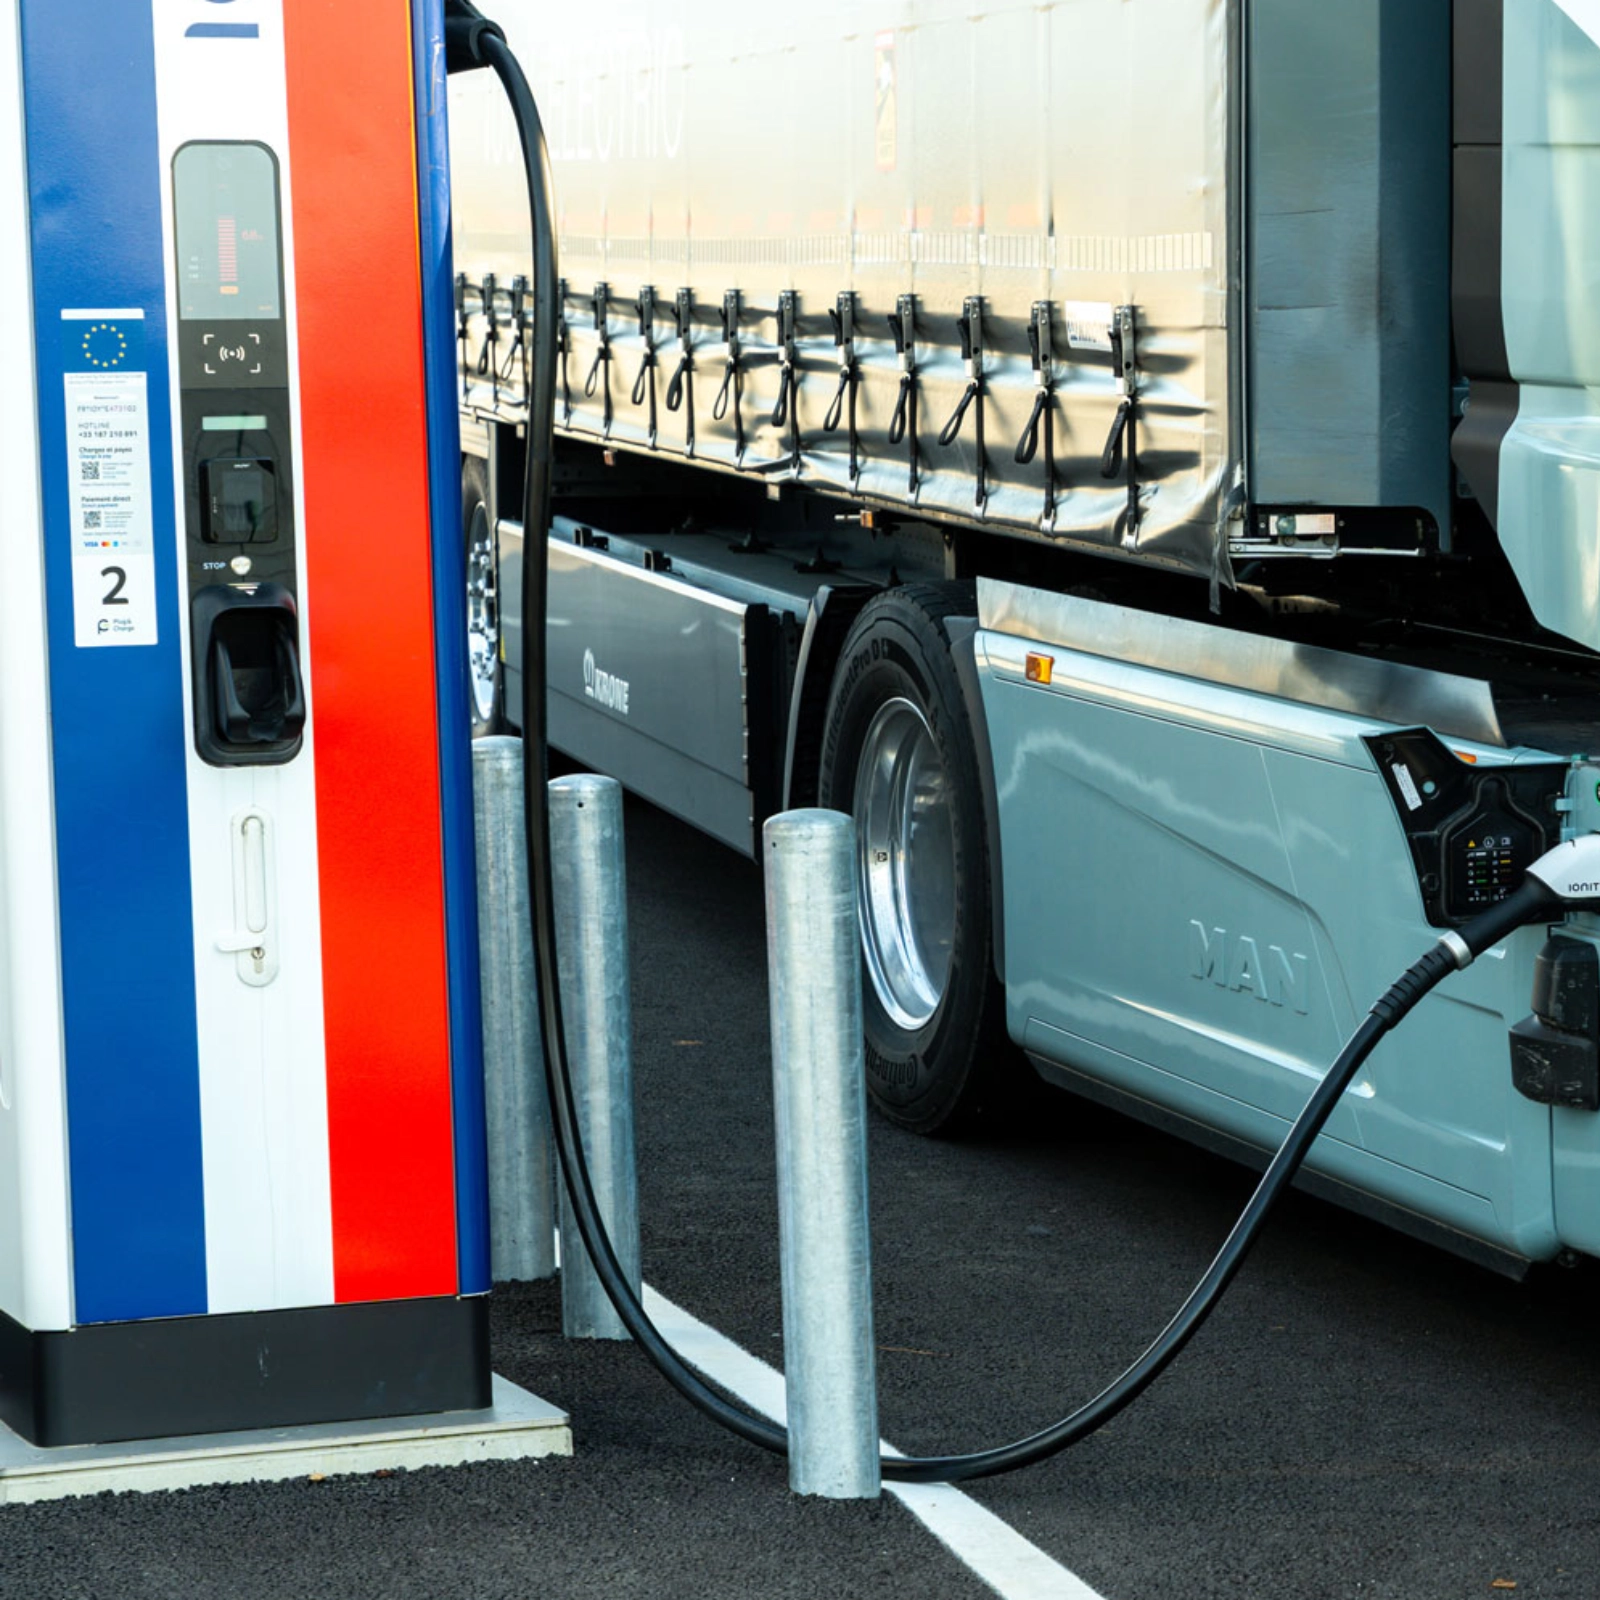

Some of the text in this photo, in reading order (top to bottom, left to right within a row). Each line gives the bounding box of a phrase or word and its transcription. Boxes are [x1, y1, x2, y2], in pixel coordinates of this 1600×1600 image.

[78, 430, 92, 438] +33
[100, 565, 129, 605] 2
[203, 562, 226, 570] STOP
[594, 667, 629, 715] KRONE
[1189, 917, 1309, 1017] MAN
